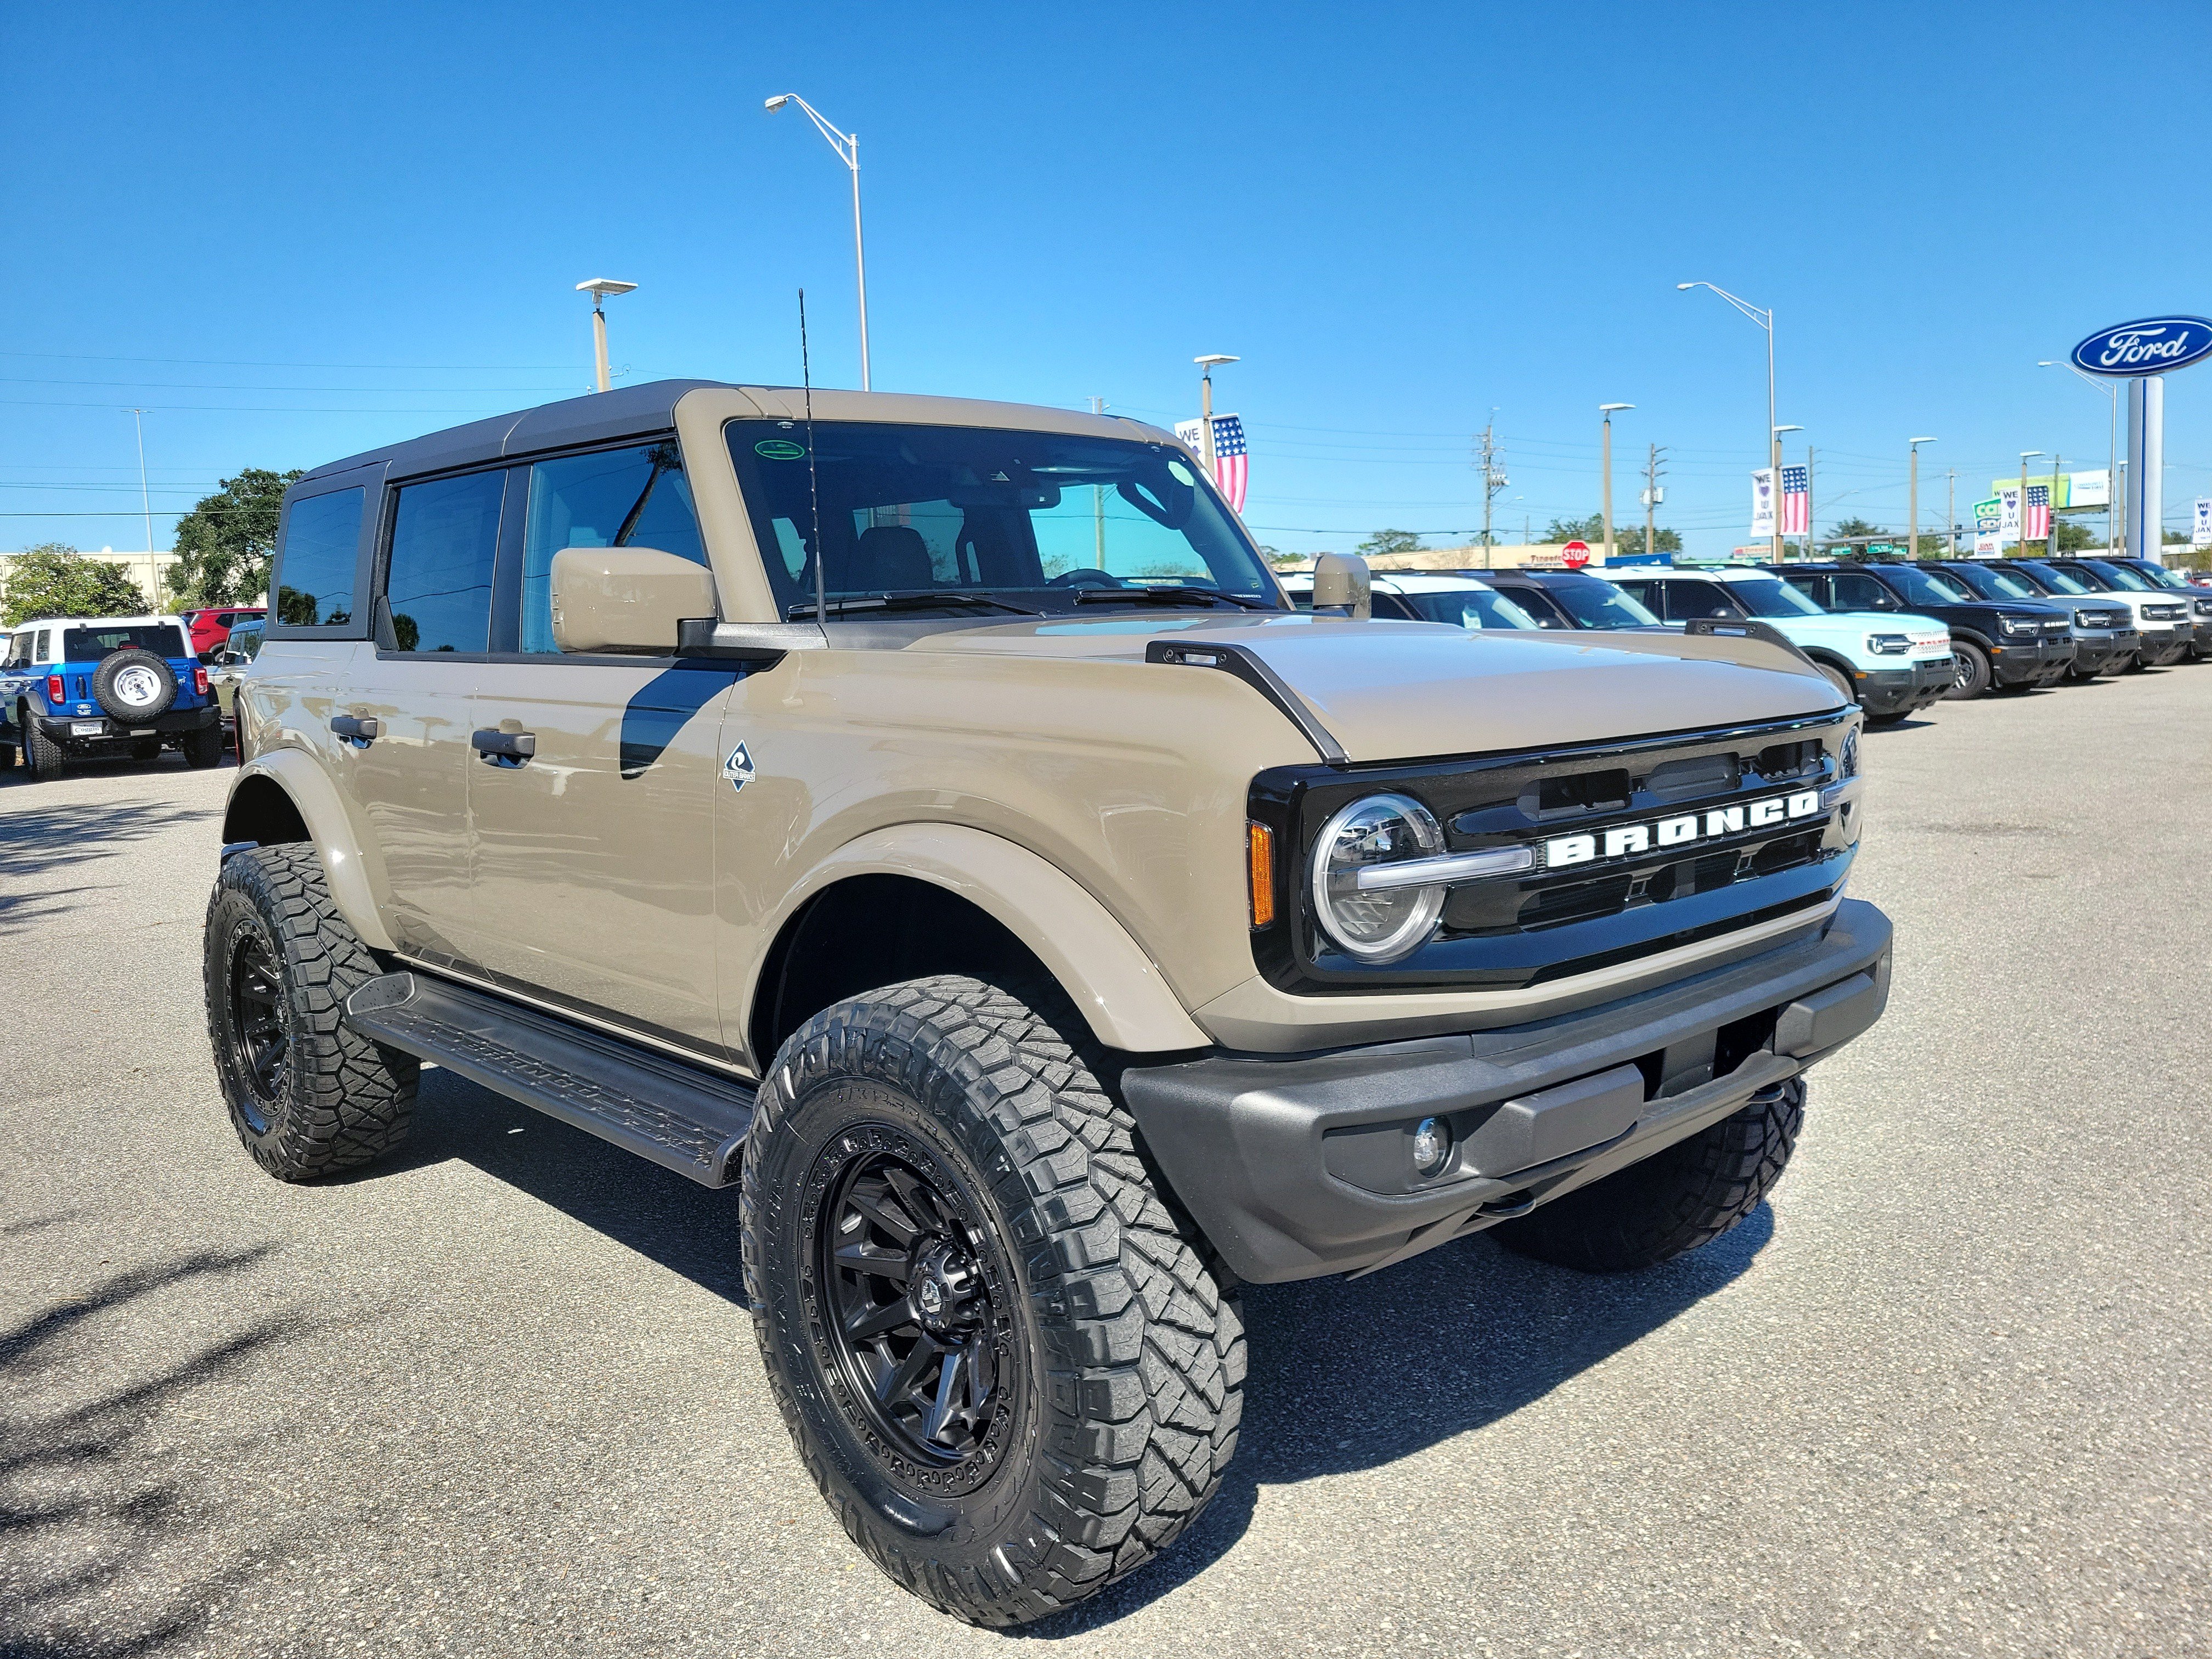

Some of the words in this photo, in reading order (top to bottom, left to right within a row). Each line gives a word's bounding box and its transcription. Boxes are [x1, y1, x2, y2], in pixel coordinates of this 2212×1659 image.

[2101, 328, 2190, 366] Ford
[1180, 428, 1199, 441] WE
[1755, 473, 1771, 483] WE
[1562, 548, 1589, 561] STOP
[1546, 790, 1819, 868] BRONCO
